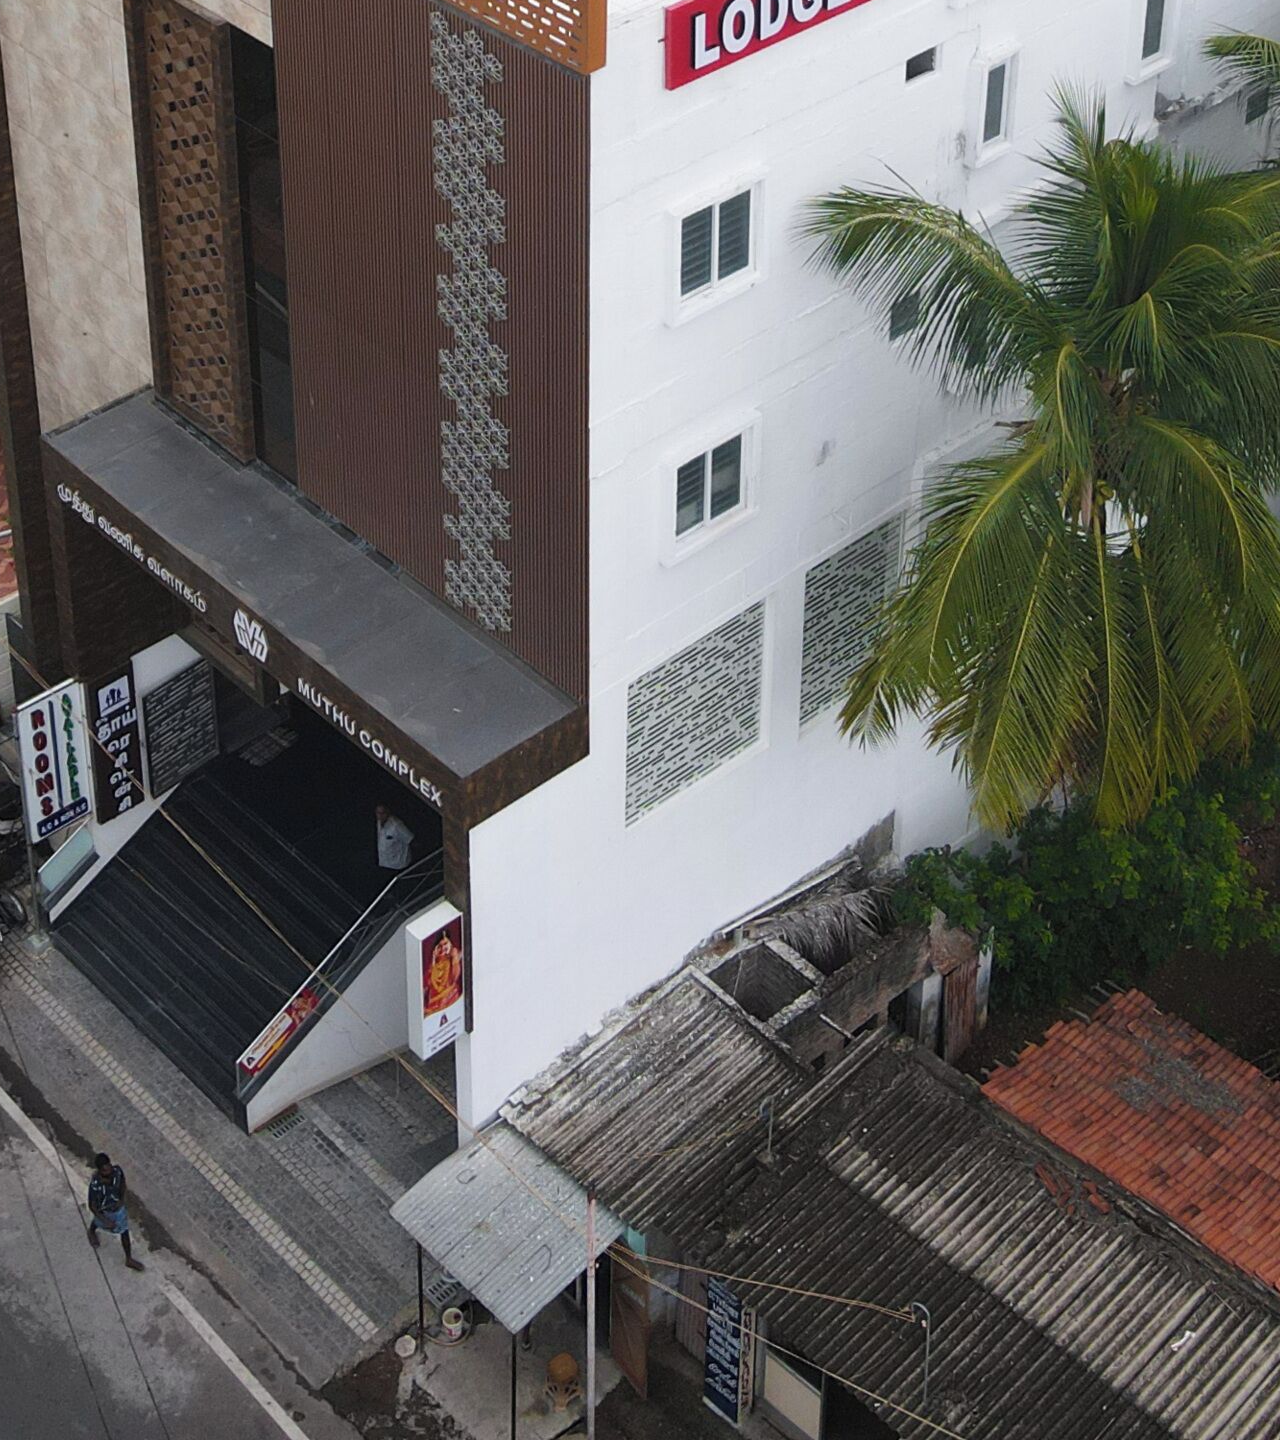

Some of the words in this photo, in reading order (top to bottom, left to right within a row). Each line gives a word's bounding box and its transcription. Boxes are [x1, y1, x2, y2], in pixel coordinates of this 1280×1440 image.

[98, 516, 144, 563] வணிக
[147, 556, 207, 613] வளாகம்
[30, 709, 55, 817] ROOMS
[297, 677, 355, 736] MUTHU
[359, 729, 443, 808] COMPLEX
